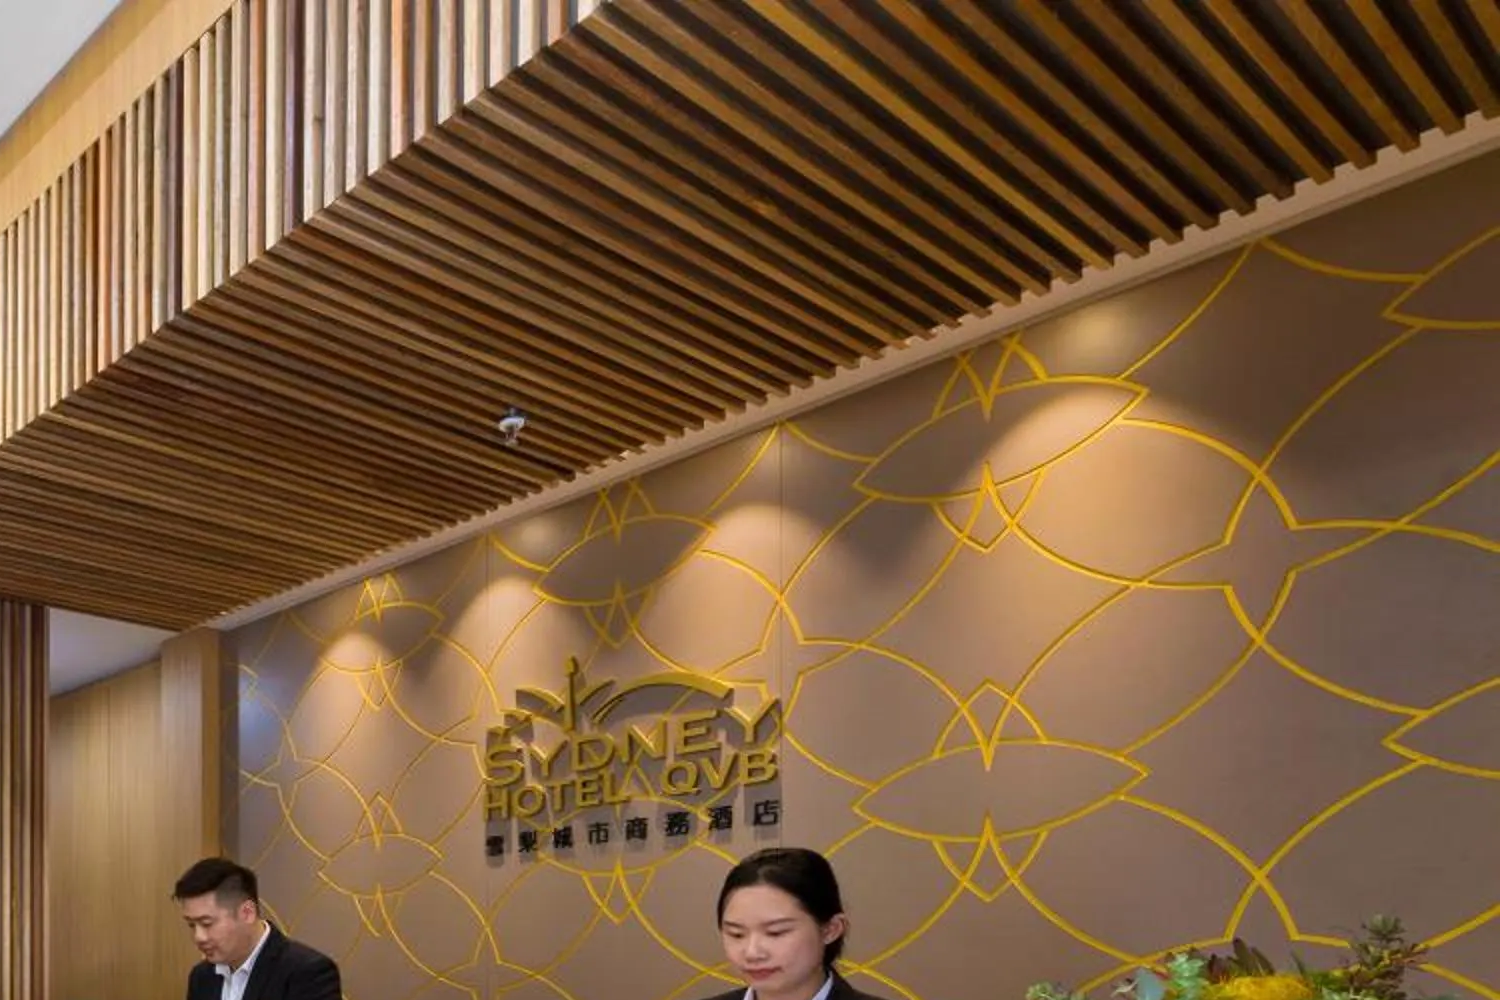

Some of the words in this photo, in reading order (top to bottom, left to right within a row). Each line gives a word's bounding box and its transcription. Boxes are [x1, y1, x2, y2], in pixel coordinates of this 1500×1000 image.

[485, 698, 782, 787] SYDNEY
[483, 771, 630, 822] HOTEL
[660, 751, 779, 797] QVB
